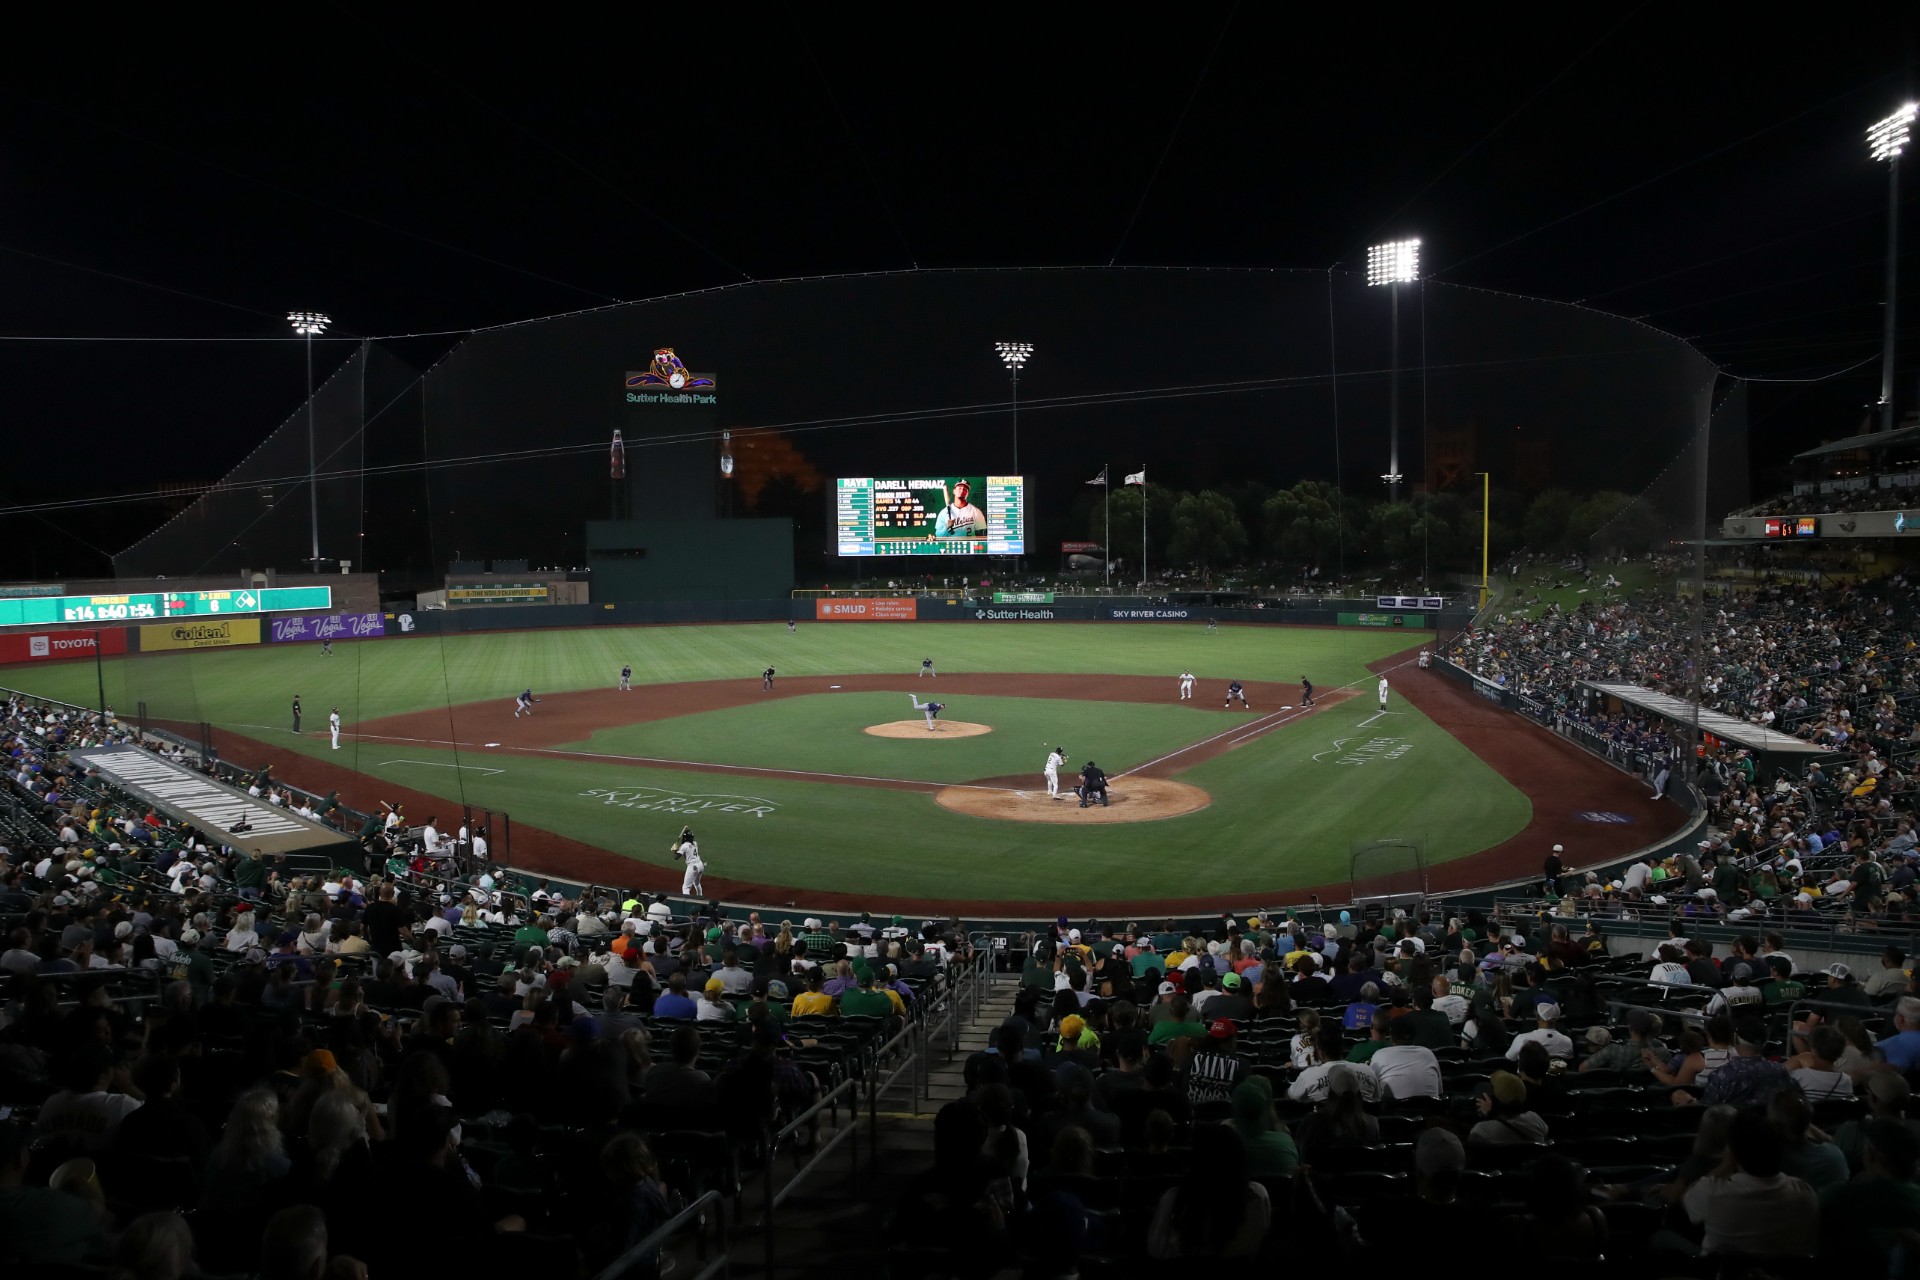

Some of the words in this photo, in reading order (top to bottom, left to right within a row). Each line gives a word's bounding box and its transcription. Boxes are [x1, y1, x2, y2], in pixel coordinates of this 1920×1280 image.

[626, 392, 659, 403] Sutter
[660, 393, 692, 403] Health
[693, 393, 717, 404] Park
[843, 479, 868, 488] RAYS
[874, 480, 907, 490] DARELL
[908, 480, 945, 489] HERNAIZ
[210, 600, 219, 612] 6
[834, 604, 866, 614] SMUD
[986, 609, 1020, 620] Sutter
[1020, 609, 1054, 619] Health
[1112, 610, 1131, 618] SKY
[1131, 610, 1155, 618] RIVER
[1156, 610, 1188, 619] CASINO
[272, 619, 309, 640] Vegas
[310, 617, 346, 638] Vegas
[348, 615, 383, 635] Vegas
[52, 638, 97, 649] TOYOTA
[578, 788, 657, 802] SKY
[656, 796, 776, 818] RIVER
[603, 800, 699, 814] CASINO
[1189, 1051, 1240, 1081] SAINT
